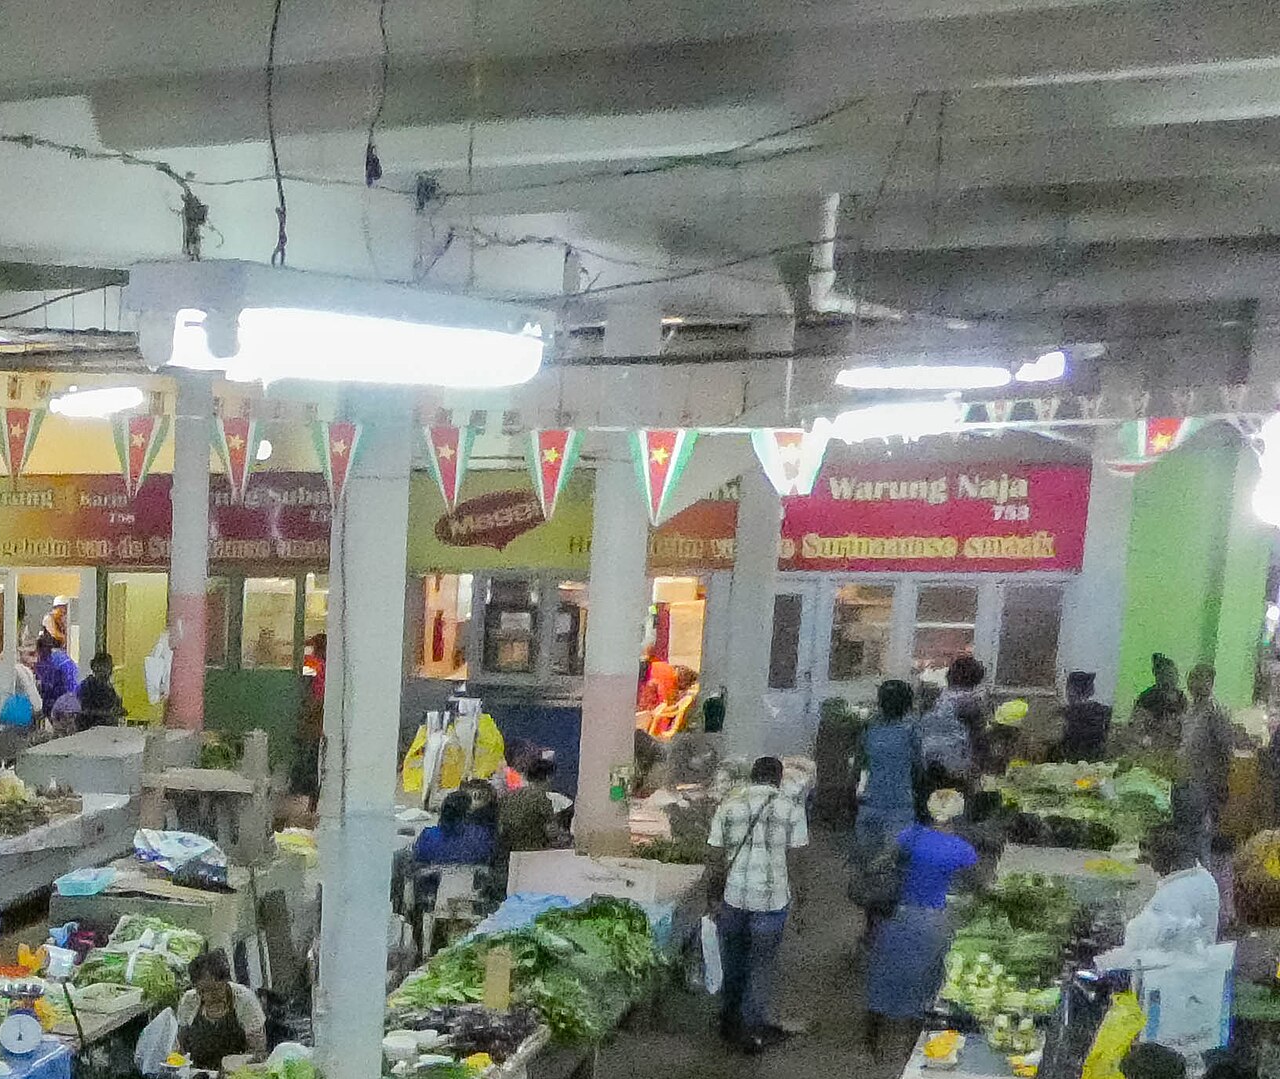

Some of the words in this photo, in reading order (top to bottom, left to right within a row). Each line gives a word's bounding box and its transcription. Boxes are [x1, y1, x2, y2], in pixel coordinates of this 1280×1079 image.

[829, 475, 947, 504] Warung
[958, 473, 1029, 504] Naja
[2, 536, 71, 560] geheim
[74, 539, 112, 559] van
[801, 533, 958, 559] Surinaamse
[963, 531, 1056, 558] smaak
